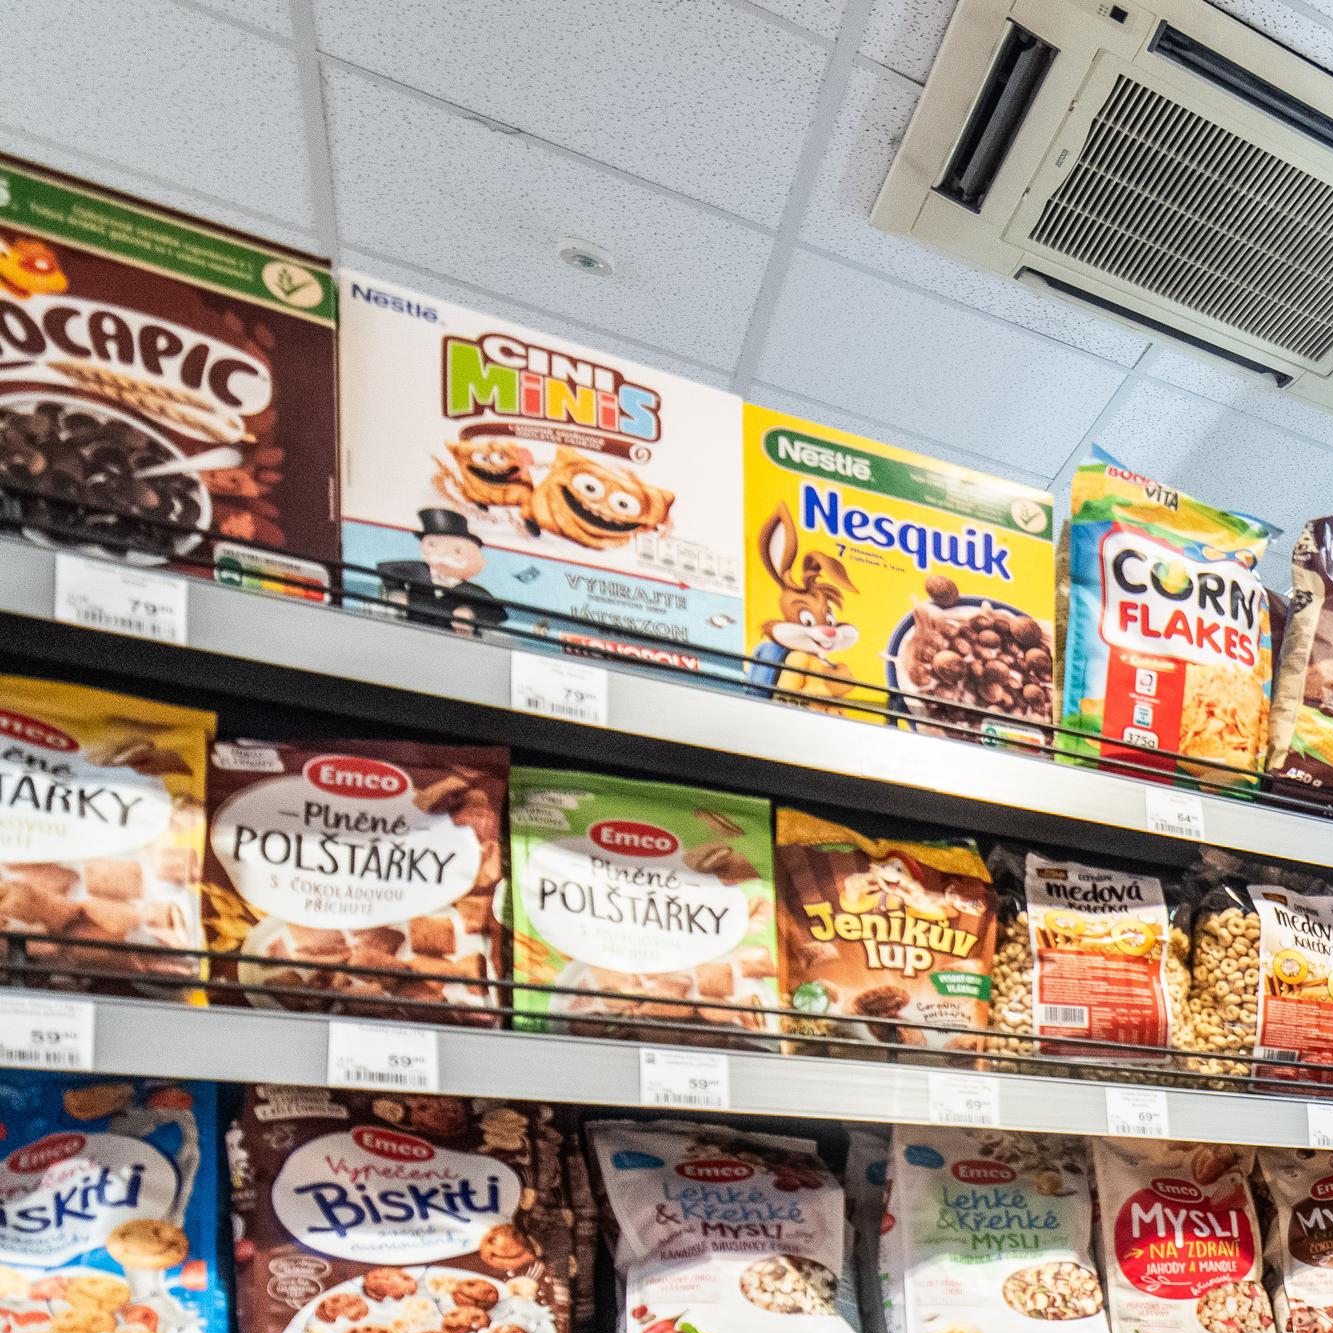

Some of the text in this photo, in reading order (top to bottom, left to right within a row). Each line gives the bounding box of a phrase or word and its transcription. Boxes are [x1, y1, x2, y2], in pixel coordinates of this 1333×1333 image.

[351, 282, 439, 324] Nestlé
[0, 302, 259, 407] OCAPIC
[482, 335, 617, 393] CINI
[777, 435, 871, 482] Nestlé
[803, 485, 1011, 580] Nesquik
[1113, 548, 1256, 629] CORN
[1119, 601, 1256, 668] FLAKES
[319, 764, 401, 792] Emco
[303, 800, 407, 837] Plněné
[232, 823, 457, 886] POLŠTÁŘKY
[600, 827, 672, 852] Emco
[538, 876, 729, 937] POLŠTÁŘKY
[1045, 880, 1144, 903] medová
[803, 902, 978, 959] Jeníkův
[863, 940, 935, 977] lup
[358, 1132, 436, 1161] Emco
[679, 1163, 749, 1180] Emco
[956, 1163, 1011, 1183] Emco
[293, 1174, 502, 1238] Biskiti
[1155, 1182, 1199, 1200] Emco
[701, 1220, 785, 1240] MYSLI
[970, 1230, 1041, 1251] MYSLI
[1131, 1203, 1240, 1249] MYSLI
[1149, 1237, 1241, 1259] NA ZDRAVÍ
[1146, 1260, 1238, 1275] JAHODY A MANDLE
